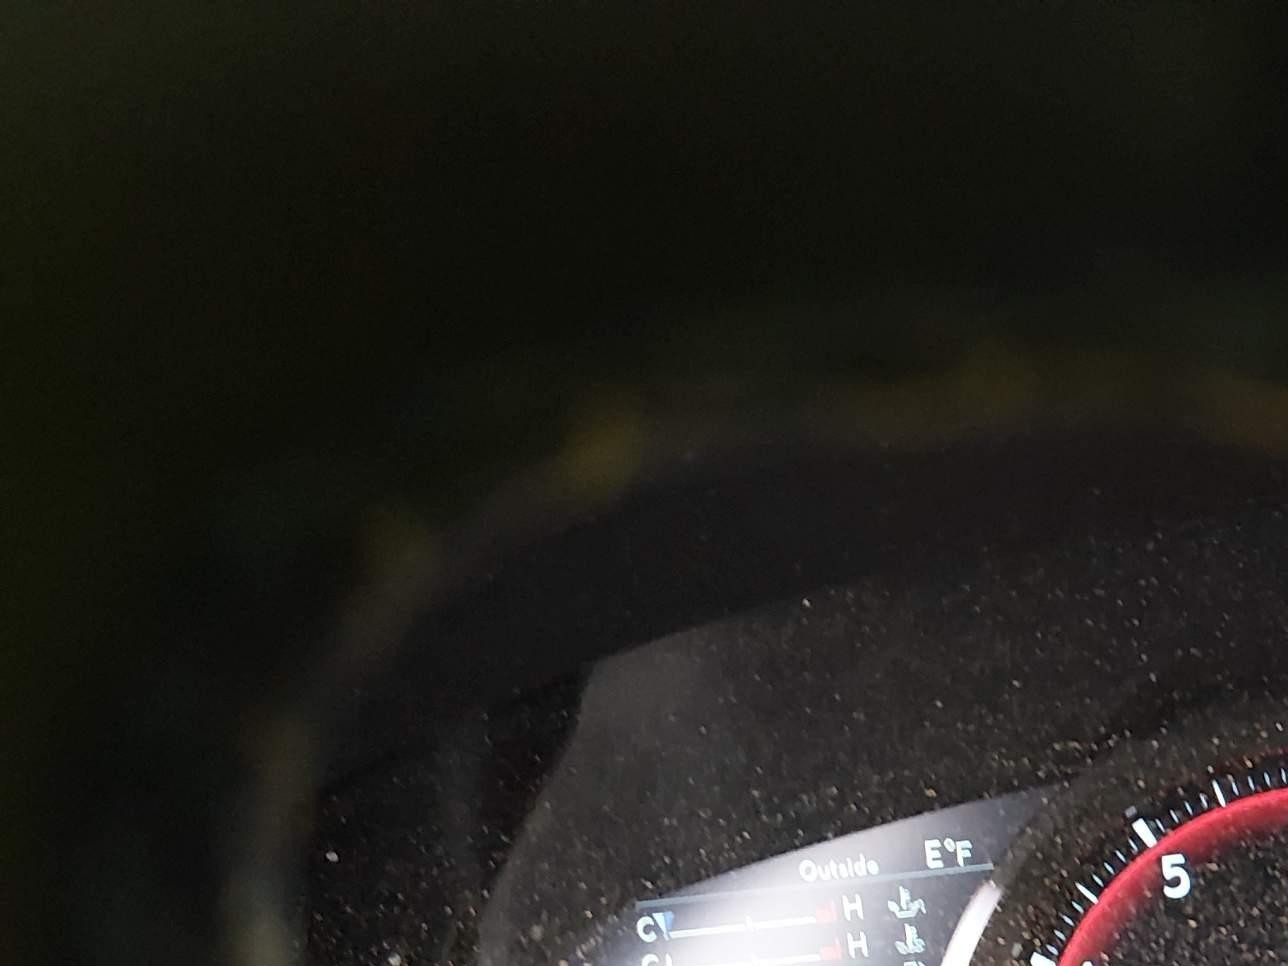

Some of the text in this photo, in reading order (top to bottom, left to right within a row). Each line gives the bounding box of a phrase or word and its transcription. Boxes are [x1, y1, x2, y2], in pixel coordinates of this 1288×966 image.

[799, 853, 880, 882] Outside
[1161, 853, 1191, 899] 5
[636, 894, 864, 943] C H
[846, 932, 870, 958] H
